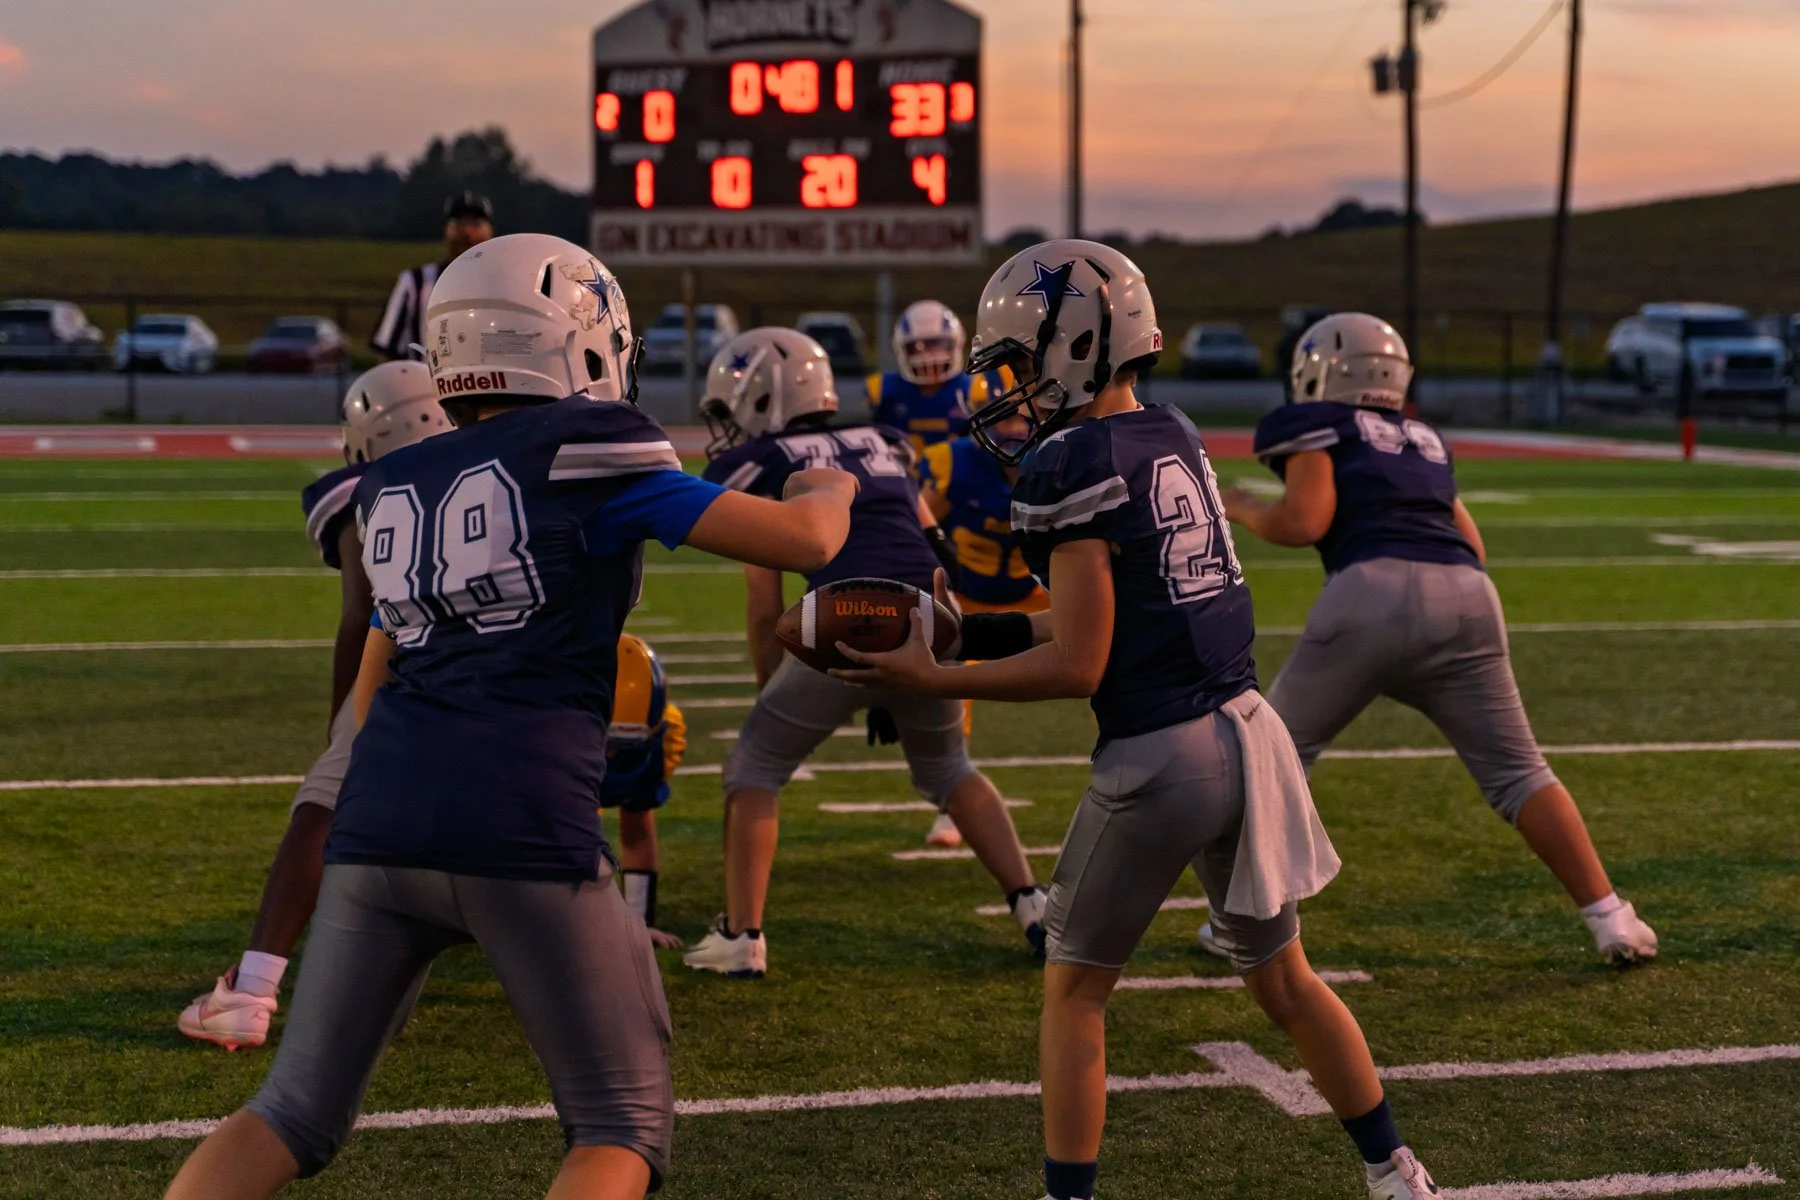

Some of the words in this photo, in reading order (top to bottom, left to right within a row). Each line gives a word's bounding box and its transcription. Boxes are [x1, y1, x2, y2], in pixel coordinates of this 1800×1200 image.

[890, 81, 946, 138] 33
[801, 153, 858, 208] 20
[911, 153, 946, 206] 4
[437, 371, 507, 396] Riddell
[834, 600, 898, 617] Wilson
